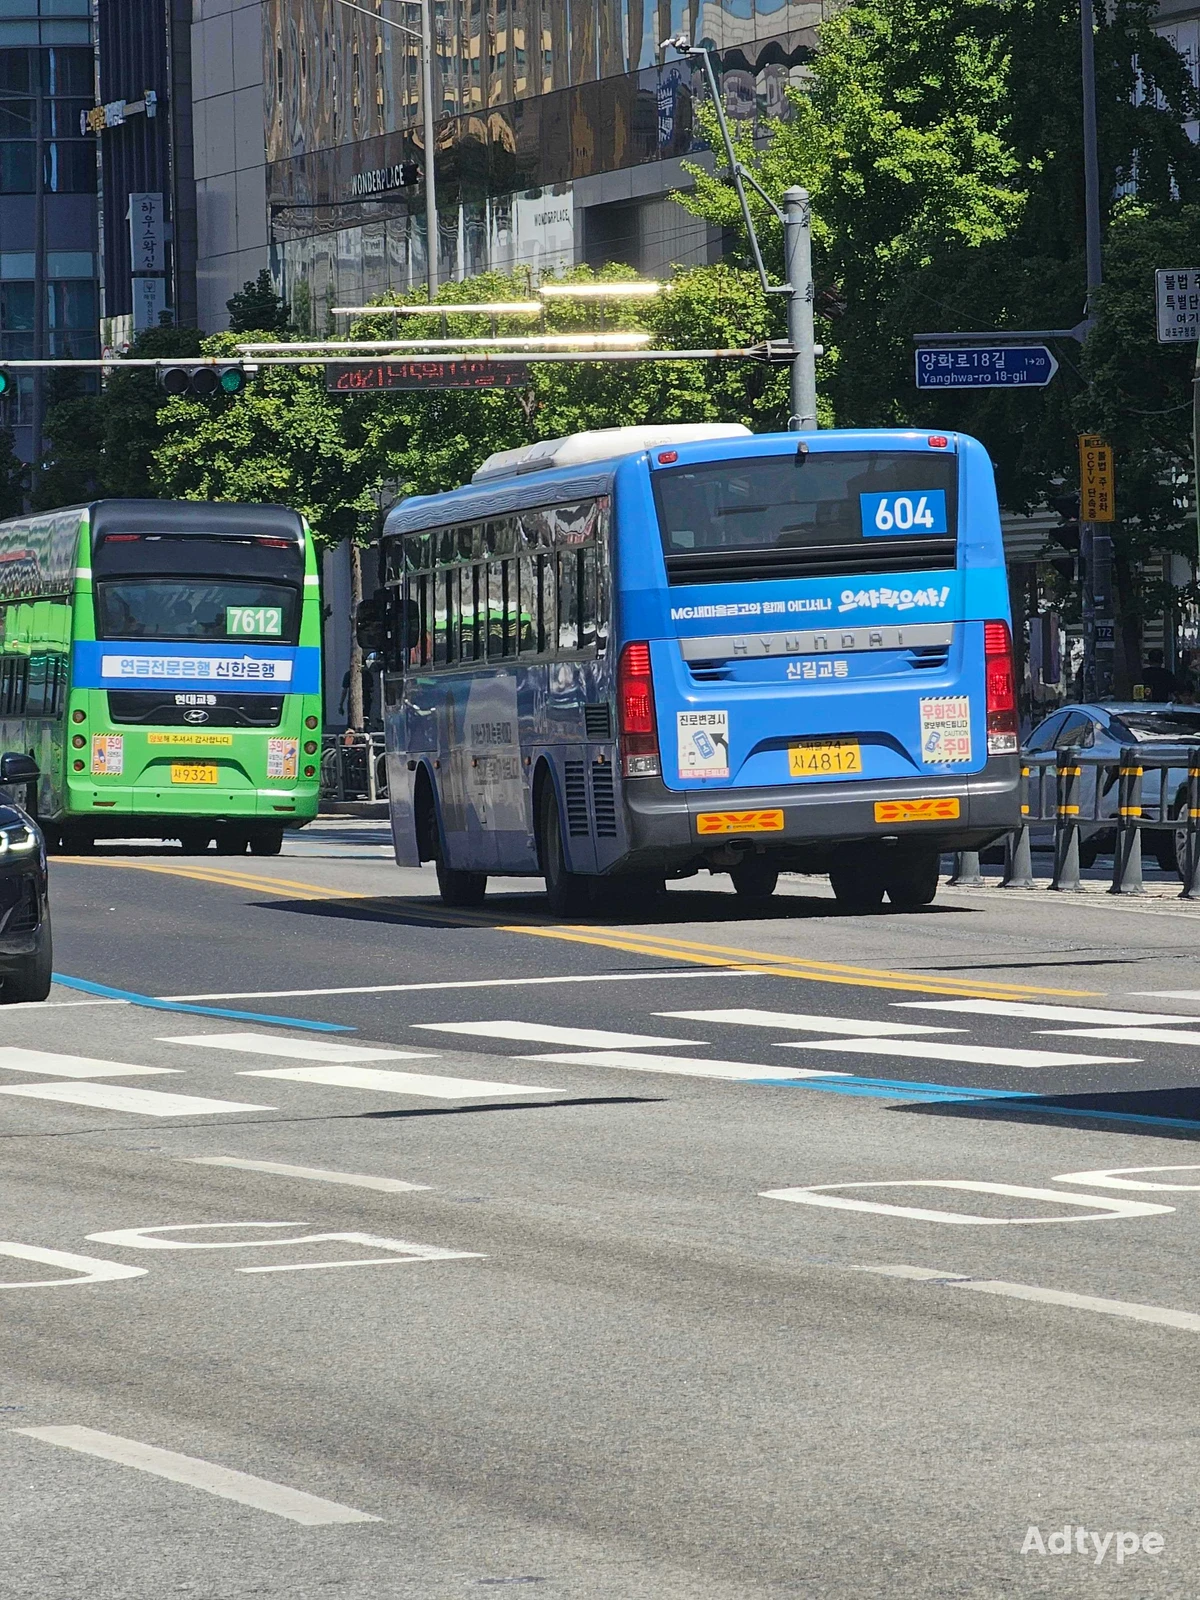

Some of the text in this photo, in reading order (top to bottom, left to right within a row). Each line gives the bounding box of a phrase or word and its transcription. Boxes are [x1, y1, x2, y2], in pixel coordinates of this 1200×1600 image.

[351, 164, 405, 196] WONDERPLACE
[141, 202, 157, 269] 하우스왁싱
[1164, 273, 1188, 291] 불법
[921, 351, 1006, 370] 양화로18길
[922, 371, 1027, 385] Yanghwa-ro 18-gil
[1086, 452, 1096, 484] CCTV
[875, 495, 934, 530] 604
[670, 604, 761, 620] MG새마을금고와
[762, 602, 786, 614] 함께
[787, 598, 833, 612] 어디서나
[229, 609, 279, 633] 7612
[1097, 627, 1112, 637] 172
[732, 629, 904, 655] HYUNDAI
[120, 659, 276, 678] 연금전문은행 신한은행
[786, 660, 849, 680] 신길교통
[679, 714, 726, 726] 진로변경시
[922, 703, 968, 720] 우회전시
[107, 737, 122, 750] 주의
[195, 736, 229, 744] 감사합니다
[269, 740, 283, 753] 주의
[943, 738, 970, 756] 주의
